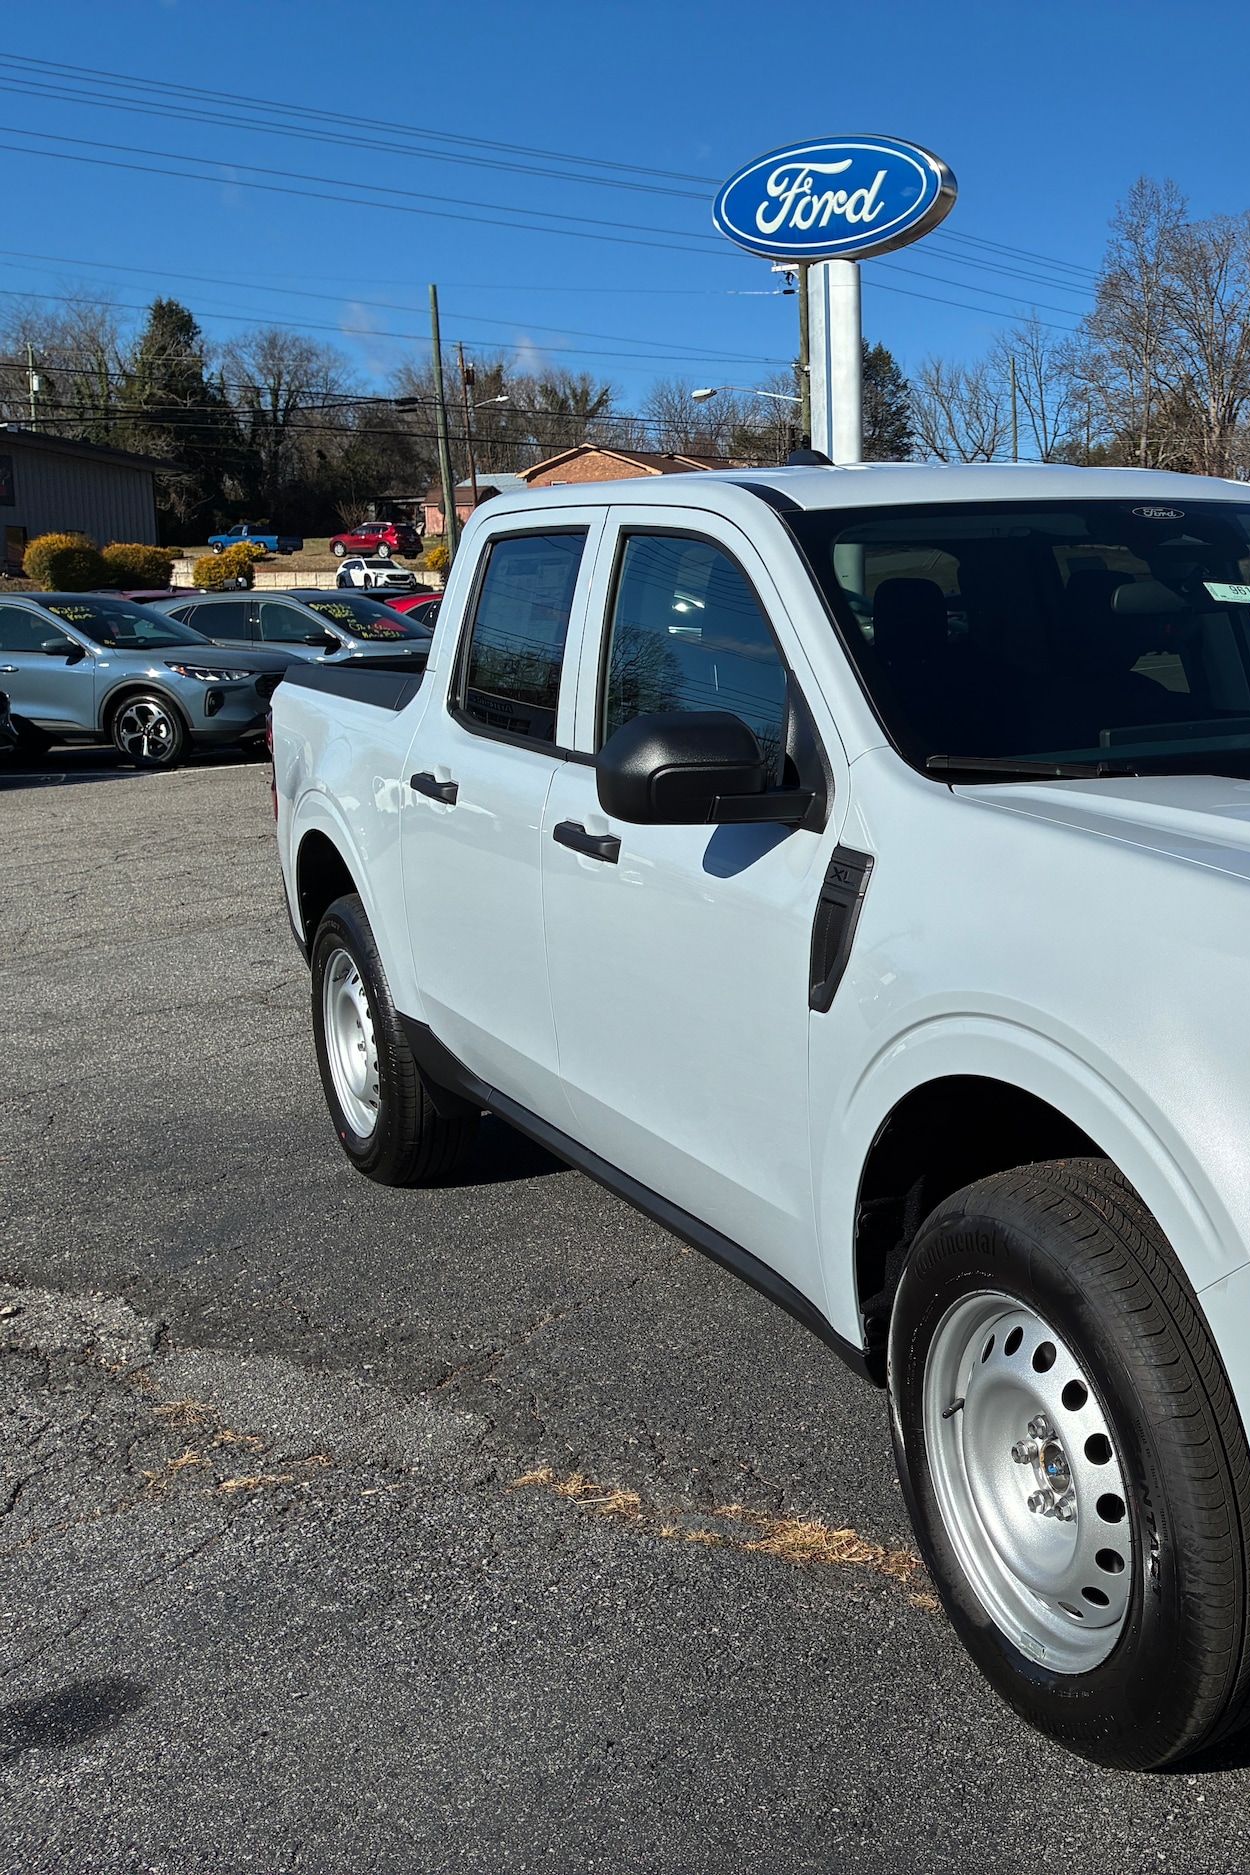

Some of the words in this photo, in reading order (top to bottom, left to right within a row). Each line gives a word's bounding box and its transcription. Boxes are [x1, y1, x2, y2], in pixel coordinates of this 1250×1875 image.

[756, 158, 888, 234] Ford
[1143, 508, 1177, 517] Ford
[830, 866, 856, 887] XL
[914, 1228, 997, 1282] Continental
